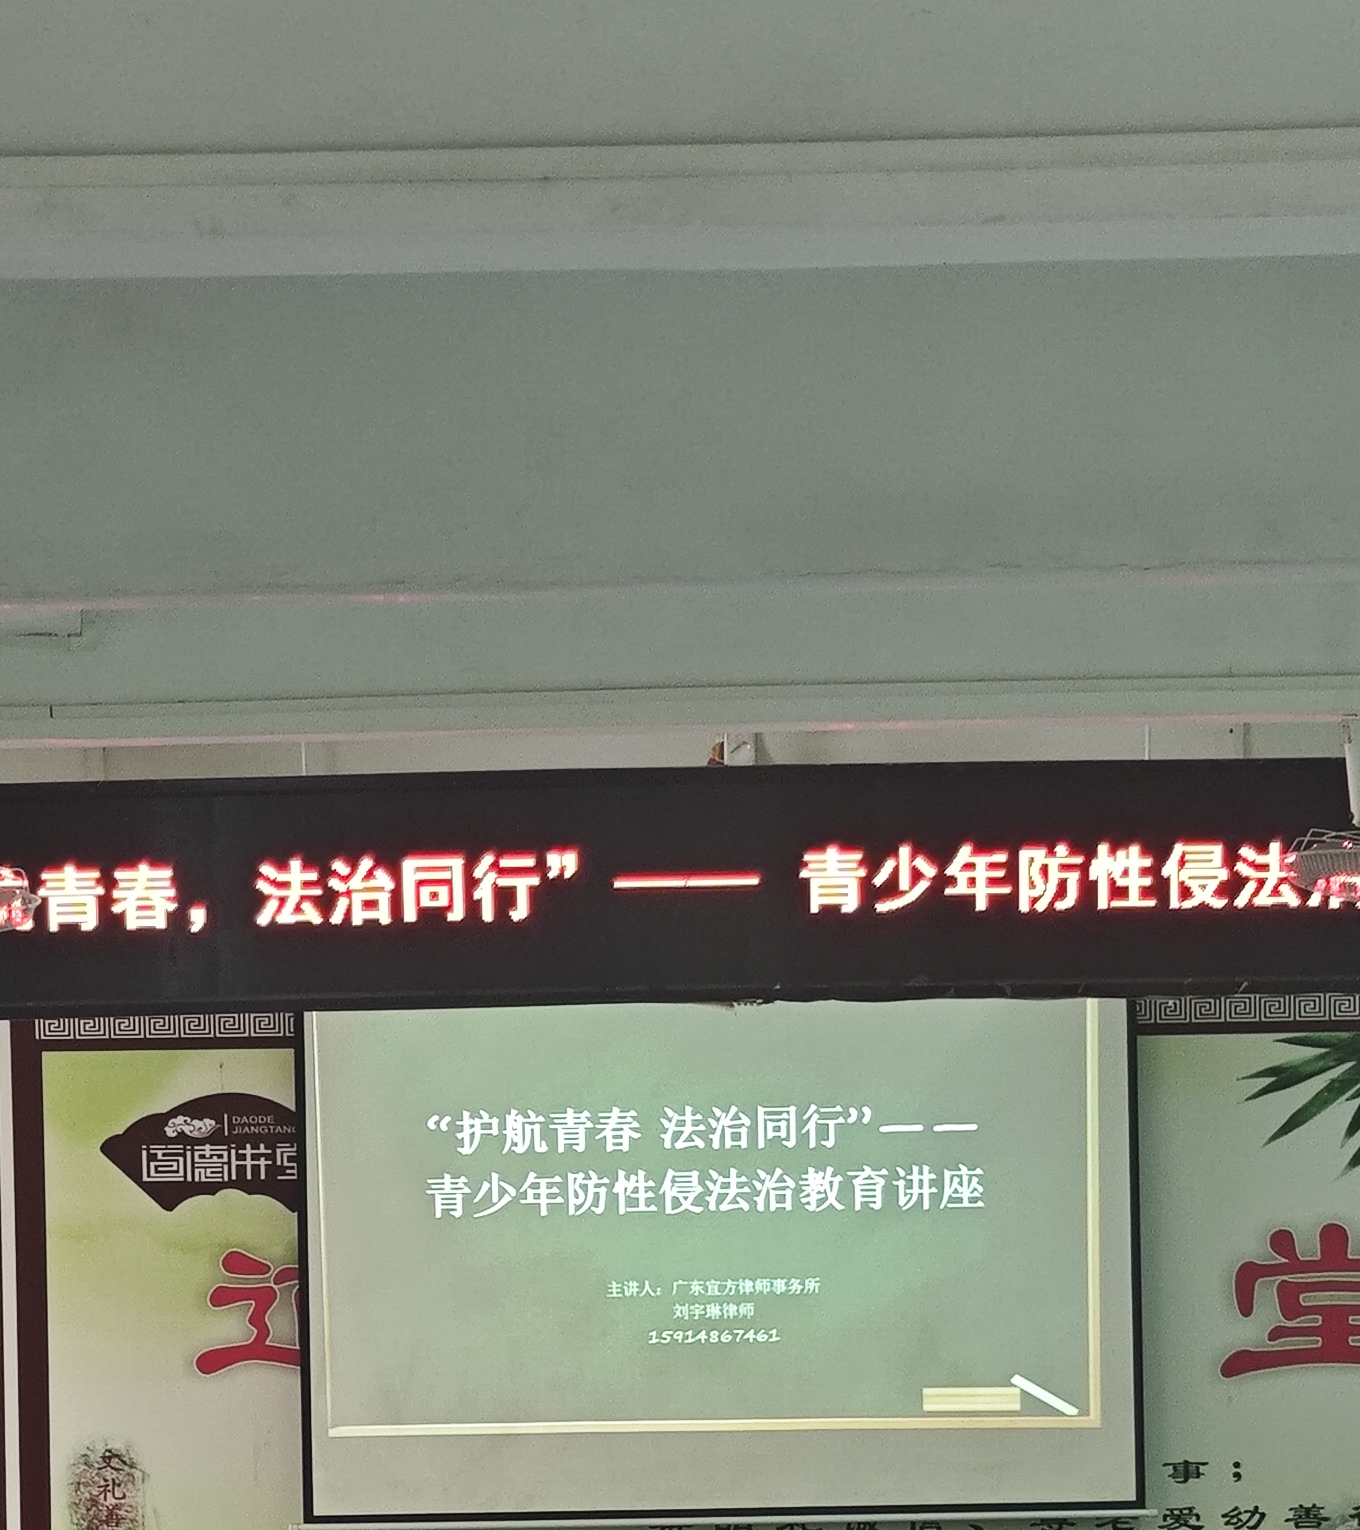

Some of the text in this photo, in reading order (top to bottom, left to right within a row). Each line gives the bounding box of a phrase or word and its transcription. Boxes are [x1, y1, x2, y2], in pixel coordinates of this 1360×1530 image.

[232, 1115, 276, 1125] DAODE
[426, 1109, 643, 1157] “护航青春
[425, 1165, 986, 1219] 青少年防性侵法治教育讲座
[647, 1328, 781, 1344] 15914867461
